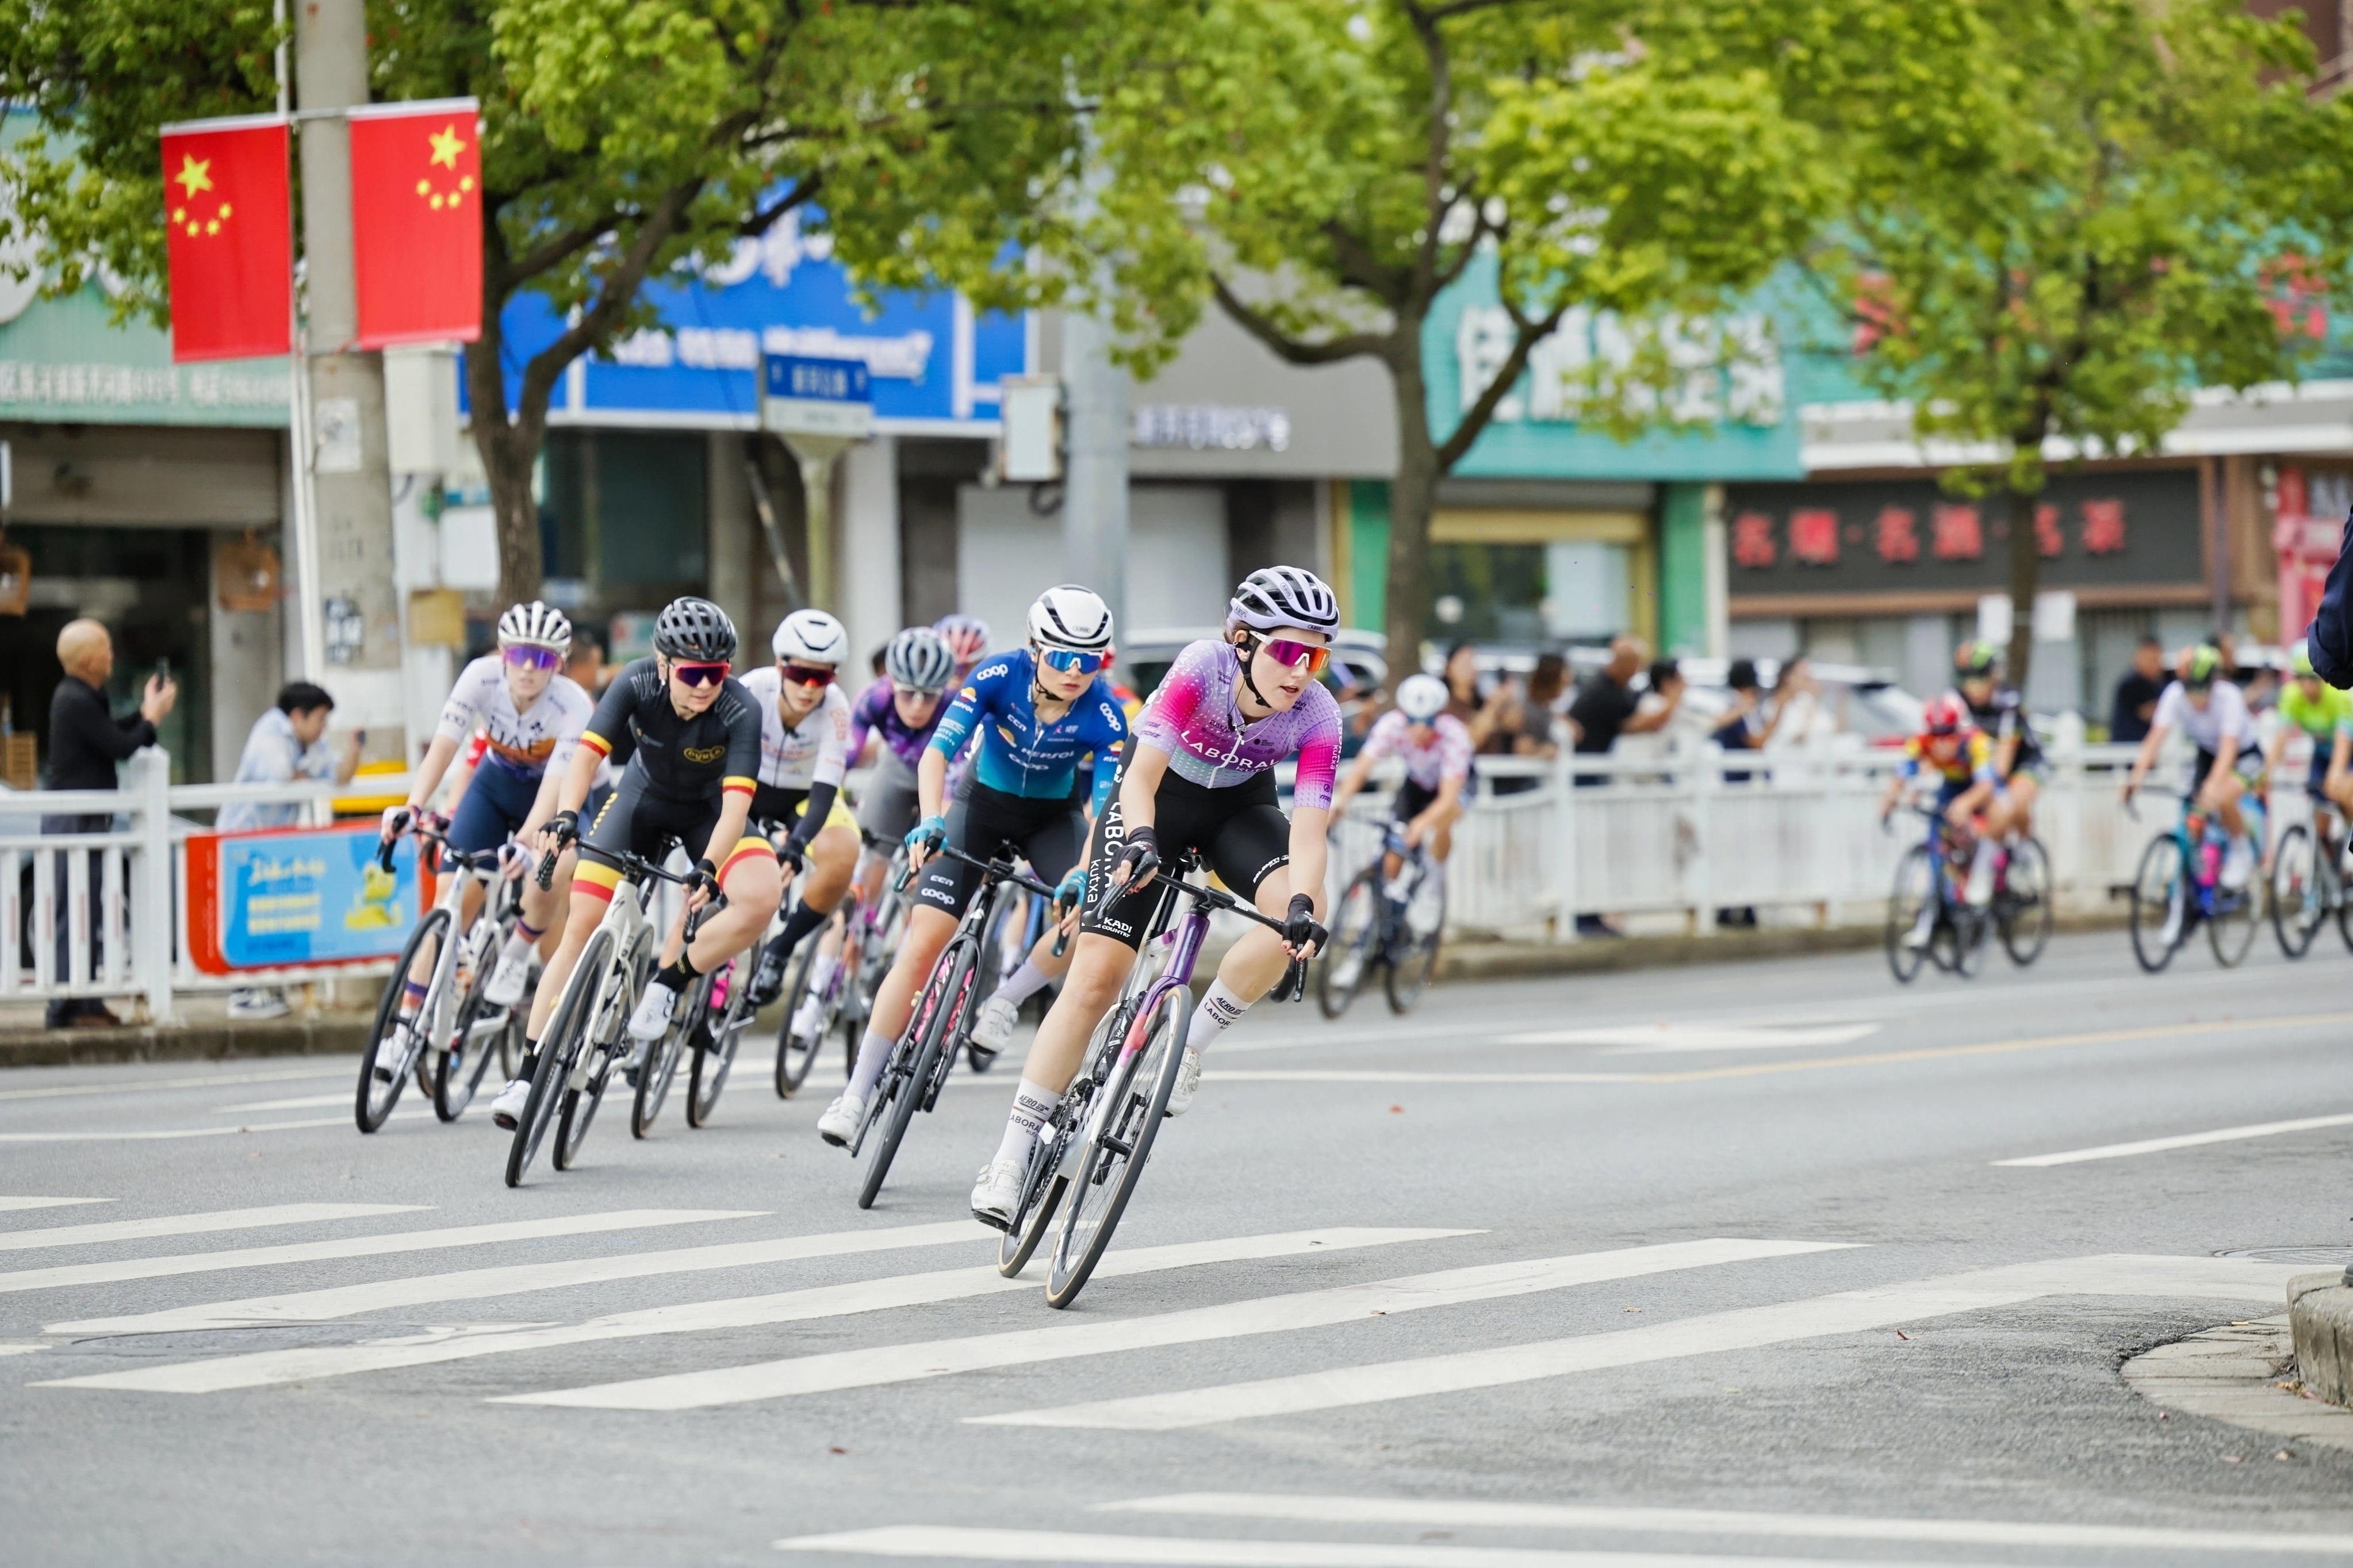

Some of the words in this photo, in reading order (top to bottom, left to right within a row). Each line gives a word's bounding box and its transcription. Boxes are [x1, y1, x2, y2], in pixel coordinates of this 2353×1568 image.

[1282, 584, 1292, 598] ABUS
[976, 664, 1009, 680] coop
[1155, 651, 1195, 704] LABORAL
[952, 699, 974, 714] REPSOL
[1099, 702, 1122, 731] coop
[1021, 747, 1075, 760] REPSOL
[1181, 730, 1279, 769] LABORAL
[1329, 745, 1339, 770] kutxa
[1008, 753, 1049, 770] coop
[1253, 857, 1280, 883] DOLOMITI
[1087, 858, 1102, 903] kutxa
[921, 887, 955, 905] coop
[1101, 925, 1131, 938] COUNTRY
[1103, 917, 1133, 933] KADI
[1216, 997, 1236, 1011] AERO
[1204, 1002, 1234, 1026] LABOR
[1018, 1094, 1037, 1107] AERO
